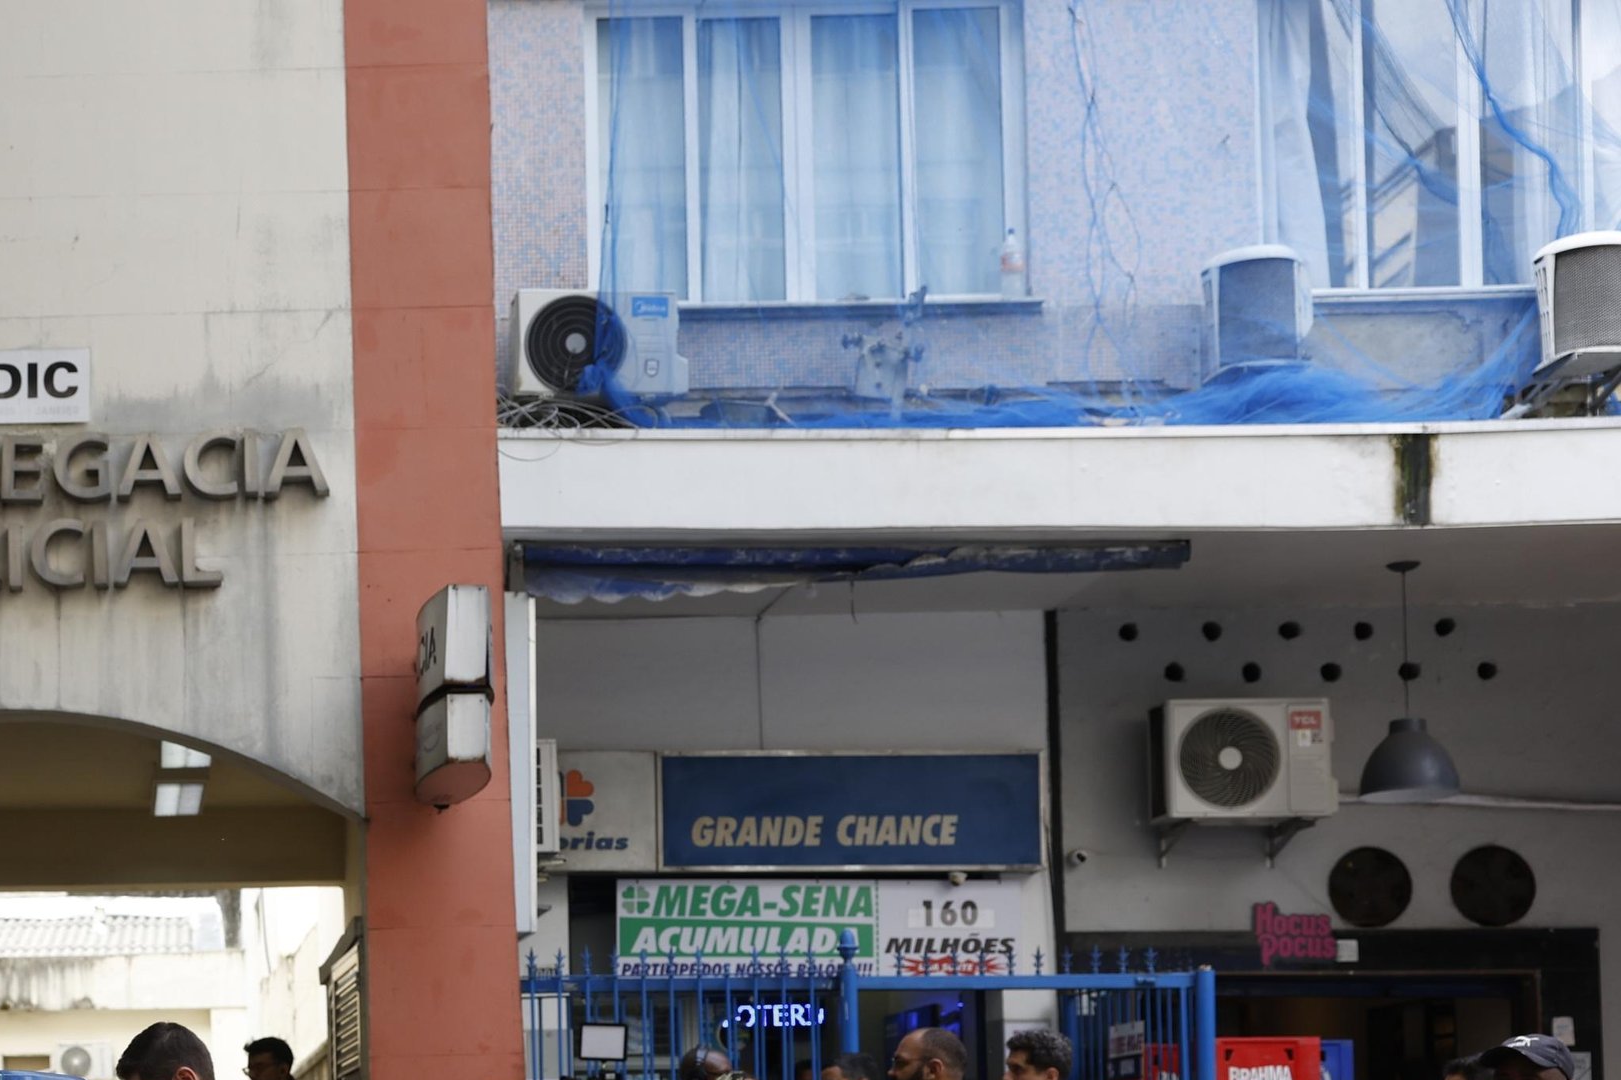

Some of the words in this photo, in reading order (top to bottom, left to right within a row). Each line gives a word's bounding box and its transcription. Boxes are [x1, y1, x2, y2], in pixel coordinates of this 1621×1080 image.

[691, 814, 825, 848] GRANDE
[836, 813, 959, 847] CHANCE
[651, 884, 874, 918] MEGA-SENA
[922, 899, 978, 927] 160
[885, 932, 1016, 955] MILHÕES
